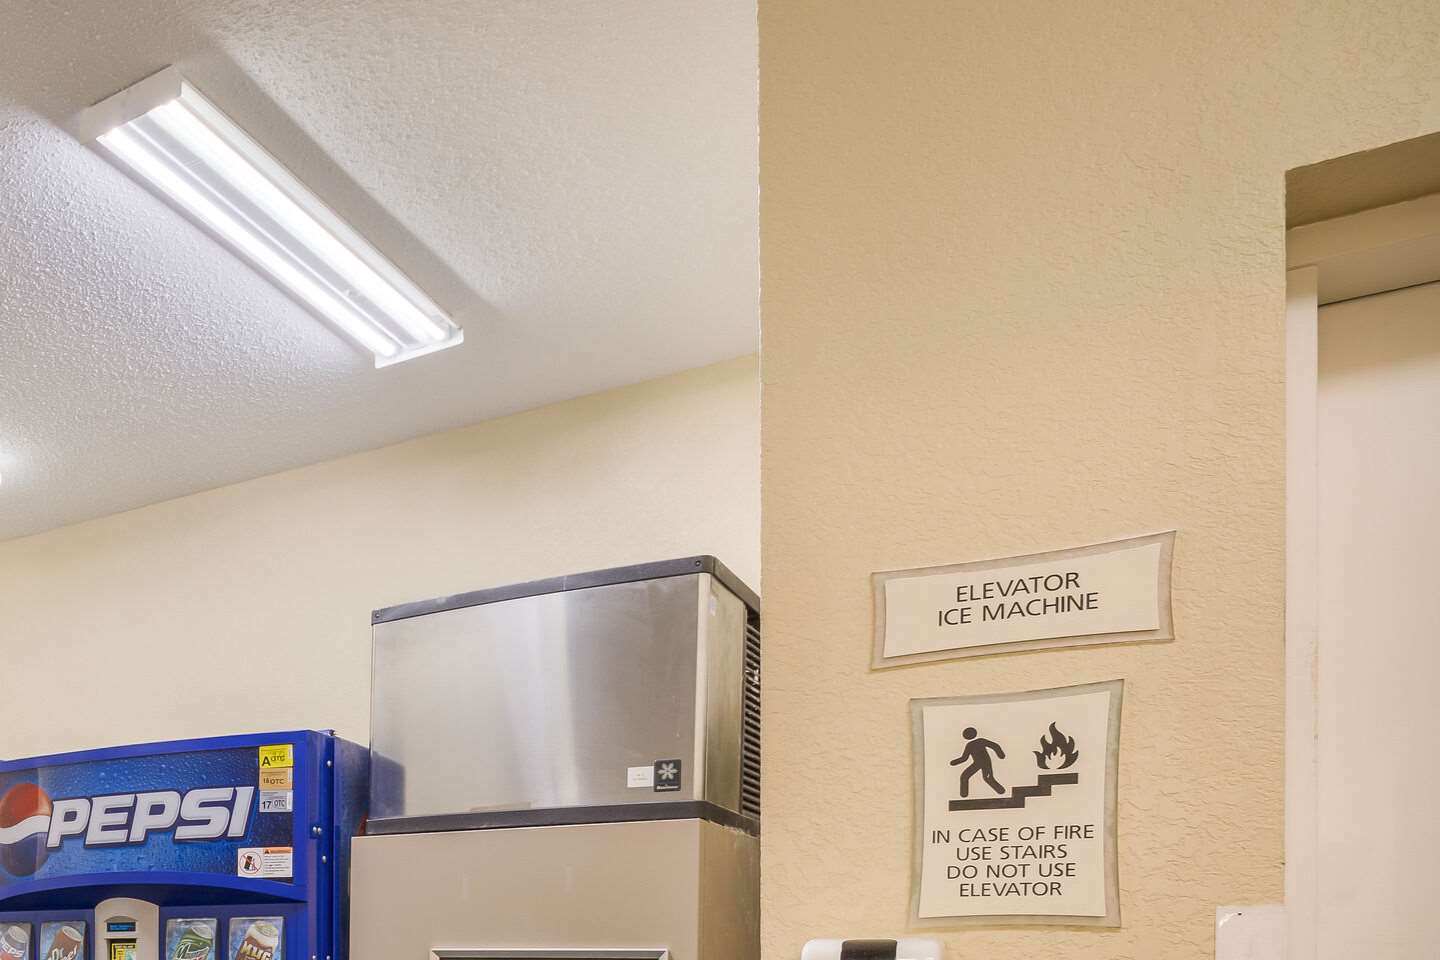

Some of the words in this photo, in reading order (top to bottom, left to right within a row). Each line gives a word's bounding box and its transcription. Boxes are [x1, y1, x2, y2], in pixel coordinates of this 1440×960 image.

[956, 572, 1080, 603] ELEVATOR
[938, 608, 972, 627] ICE
[982, 592, 1099, 623] MACHINE
[262, 757, 271, 766] A
[262, 801, 272, 809] 17
[47, 786, 254, 848] PEPSI
[932, 830, 950, 844] IN
[959, 827, 1009, 843] CASE
[1018, 826, 1045, 841] OF
[1054, 824, 1095, 840] FIRE
[956, 846, 991, 861] USE
[1000, 844, 1068, 860] STAIRS
[947, 865, 978, 880] DO
[987, 863, 1029, 879] NOT
[1039, 862, 1076, 877] USE
[959, 882, 1062, 897] ELEVATOR
